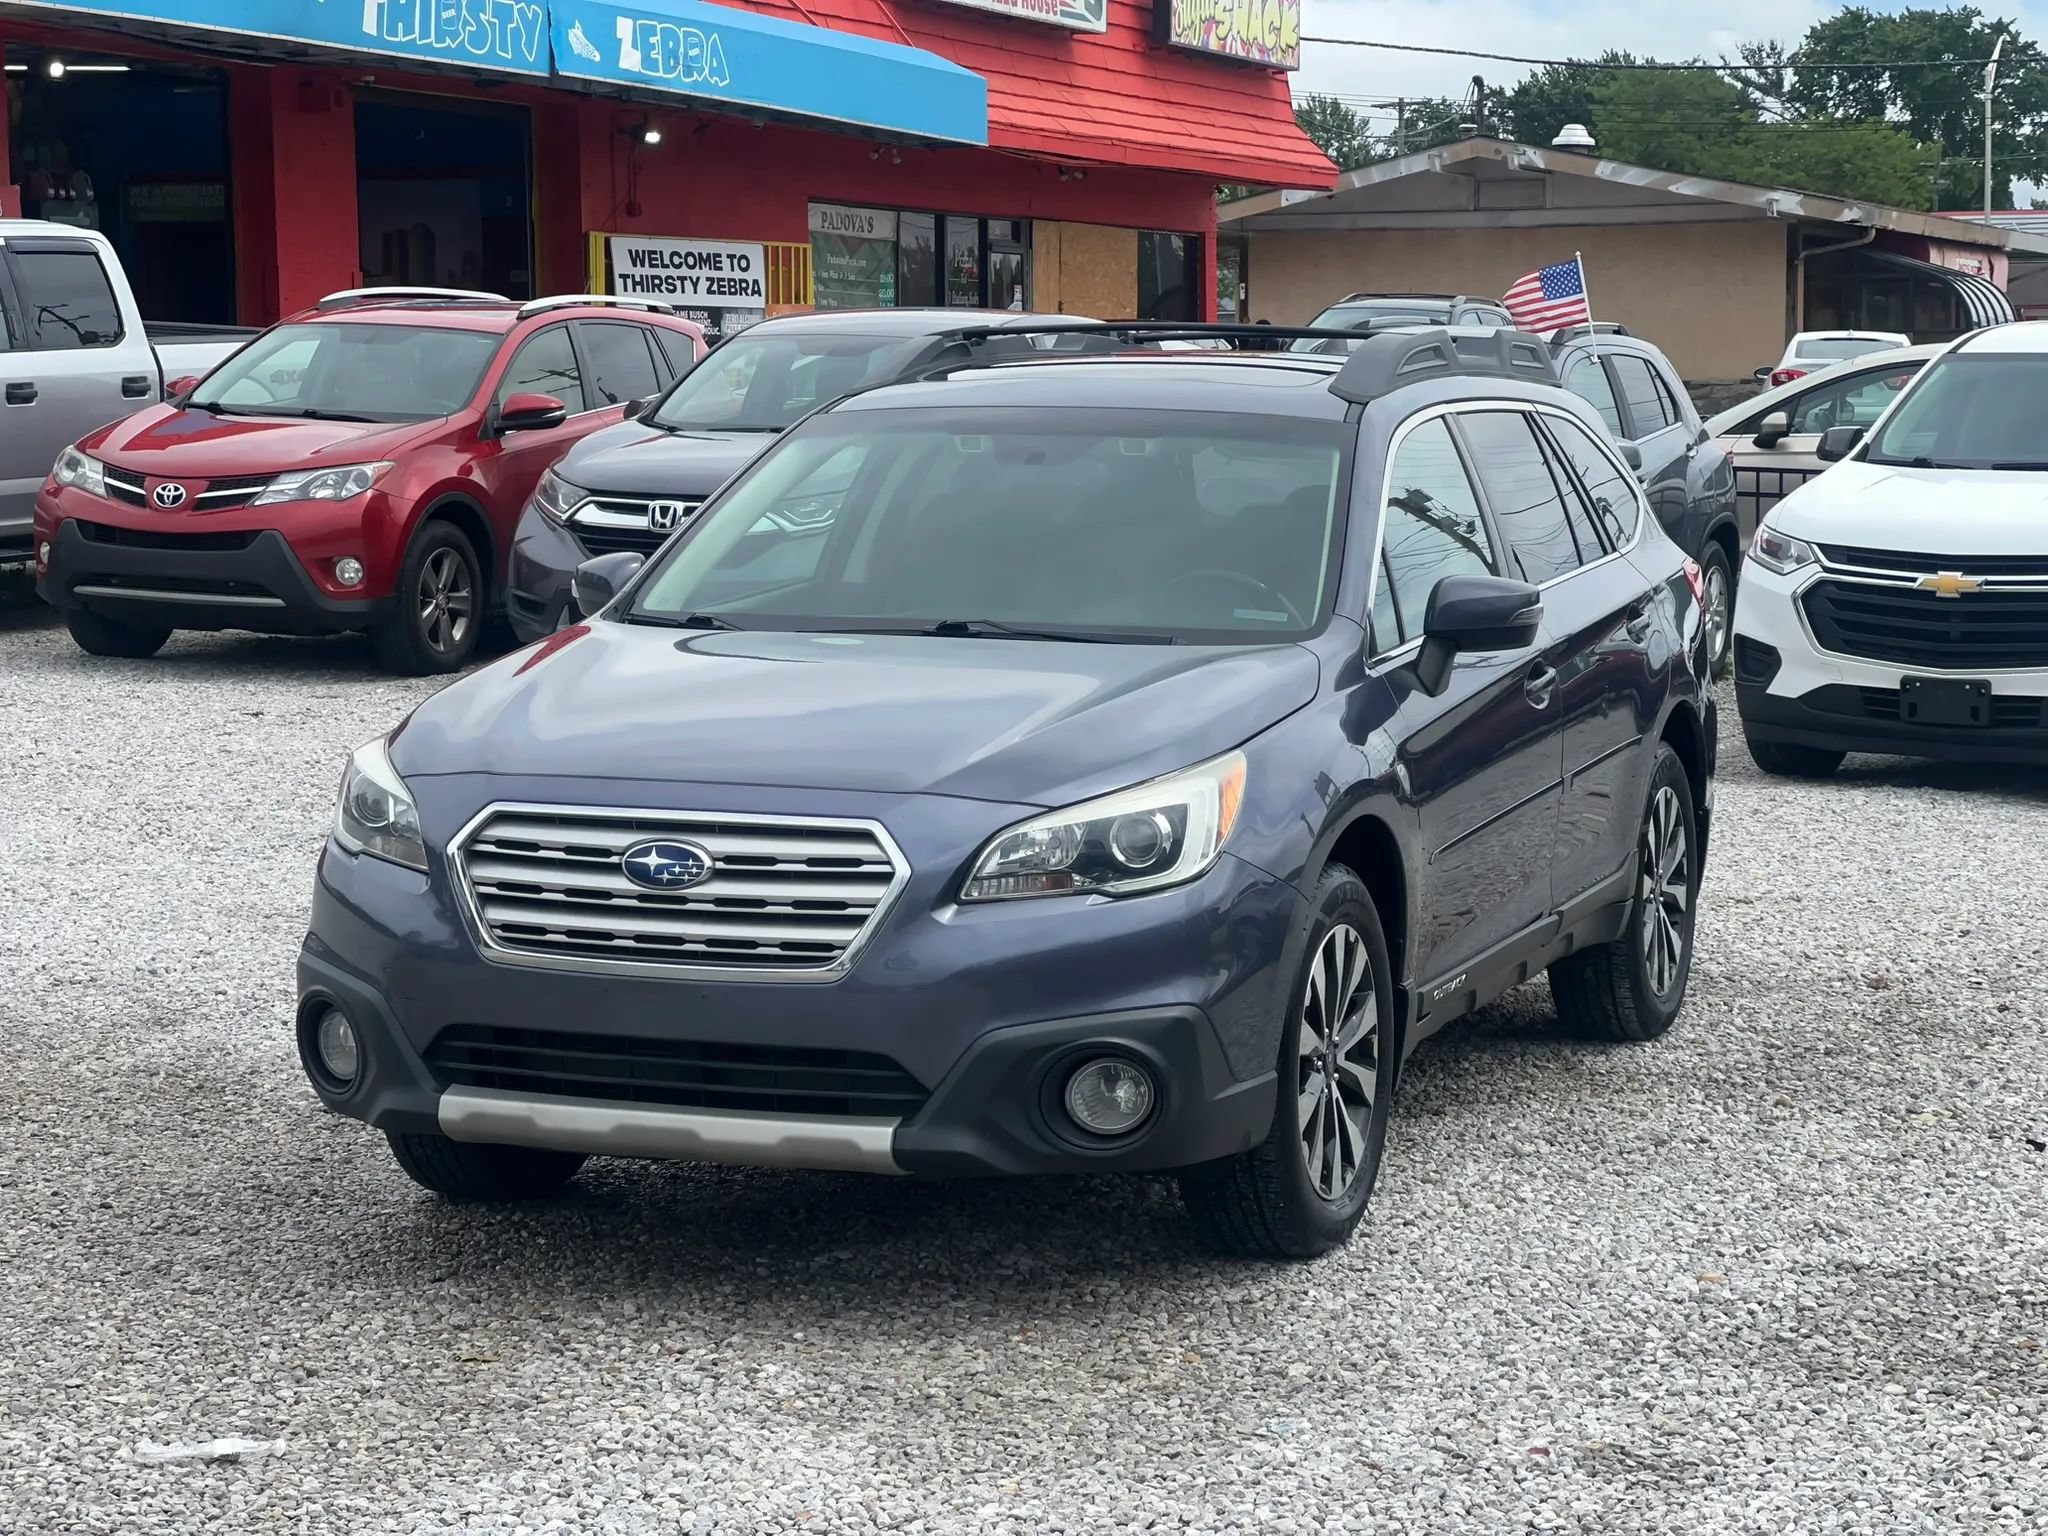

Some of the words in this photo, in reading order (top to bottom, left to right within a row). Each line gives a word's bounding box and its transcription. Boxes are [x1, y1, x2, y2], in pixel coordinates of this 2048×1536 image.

[362, 0, 543, 62] THIRSTY
[616, 15, 730, 87] ZEBRA
[820, 211, 874, 233] PADOVA'S
[627, 248, 722, 272] WELCOME
[726, 253, 751, 273] TO
[618, 273, 701, 295] THIRSTY
[705, 276, 763, 298] ZEBRA
